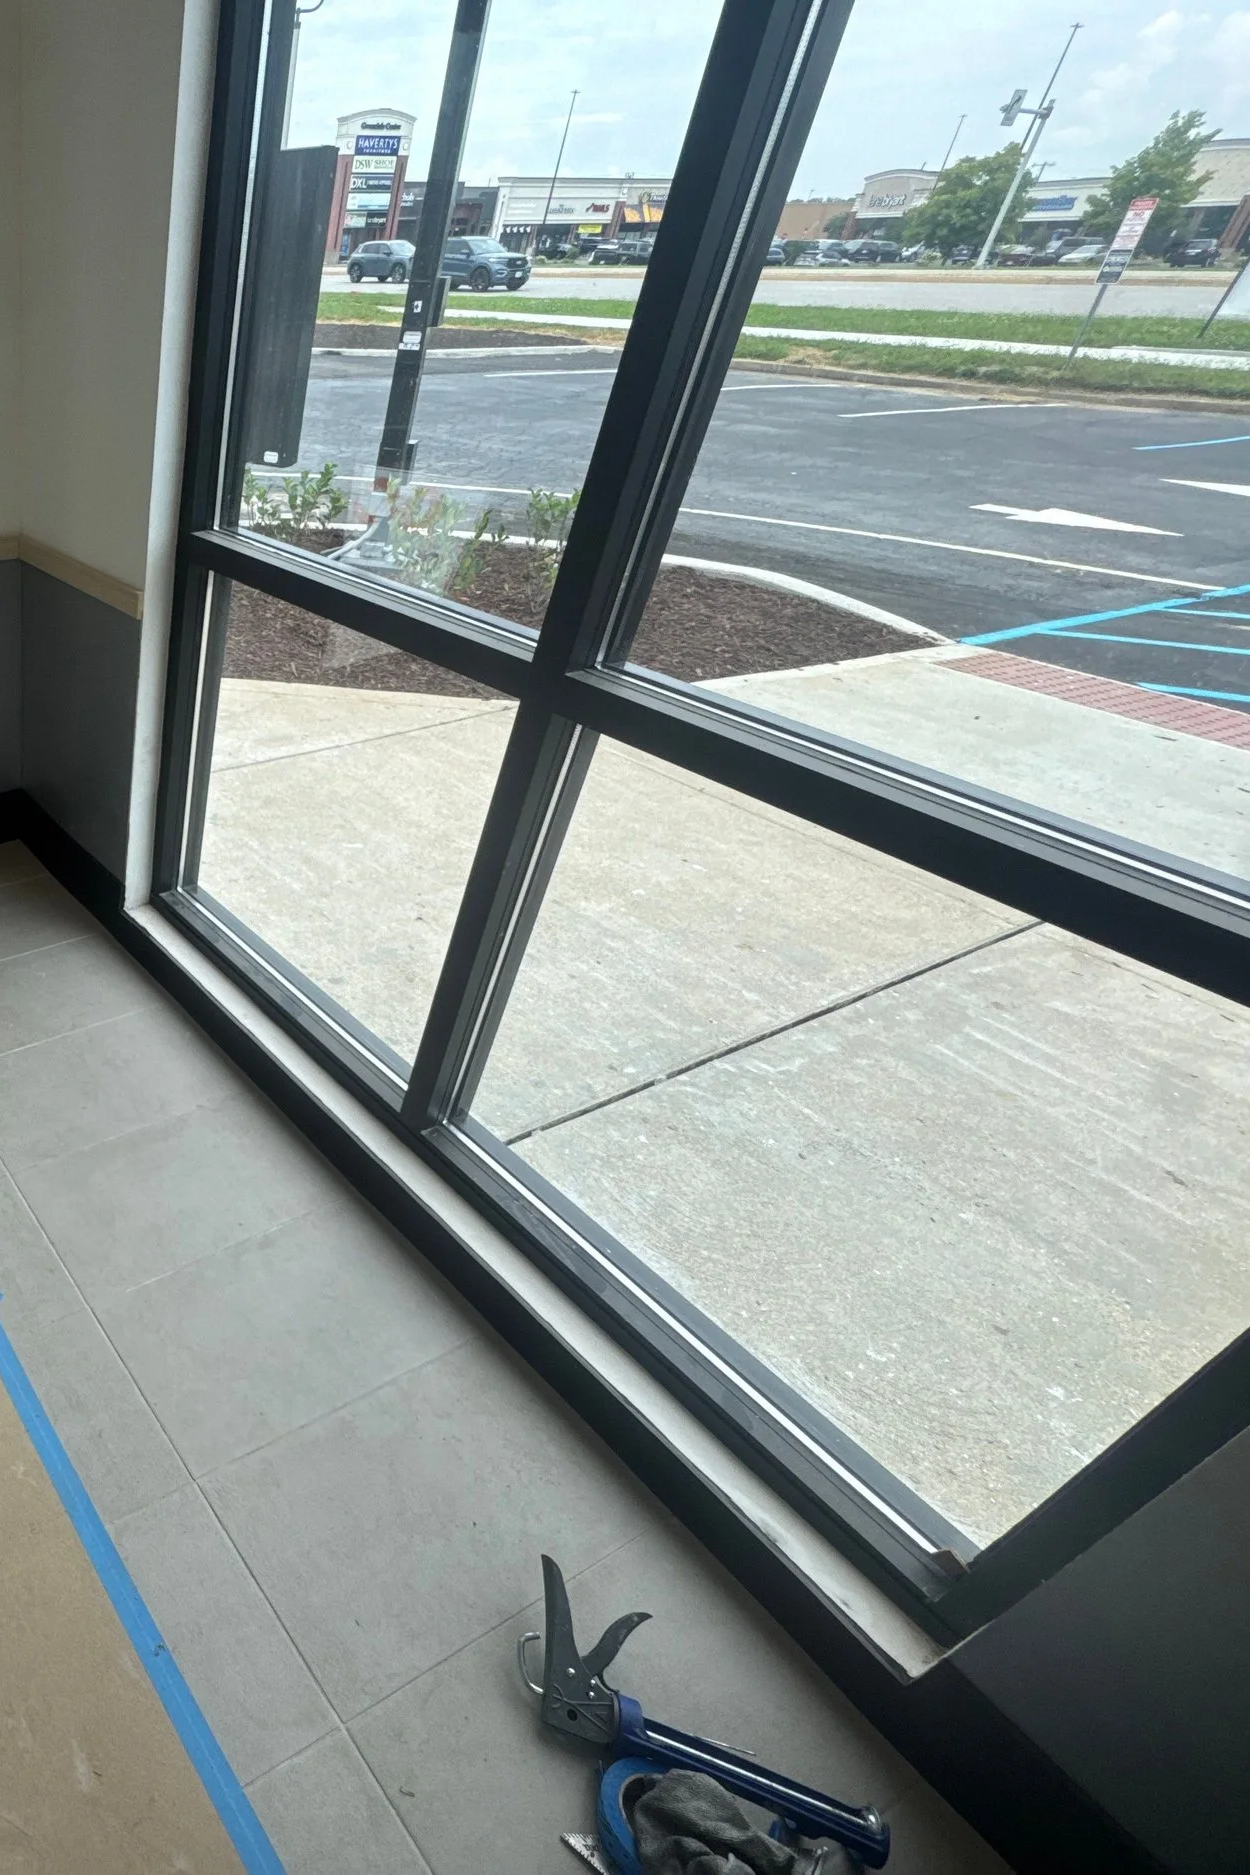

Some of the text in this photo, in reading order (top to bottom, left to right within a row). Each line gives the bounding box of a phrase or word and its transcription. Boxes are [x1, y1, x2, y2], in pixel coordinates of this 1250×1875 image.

[358, 137, 398, 149] HAVERTYS
[354, 160, 372, 170] DSW
[351, 178, 367, 189] DXL
